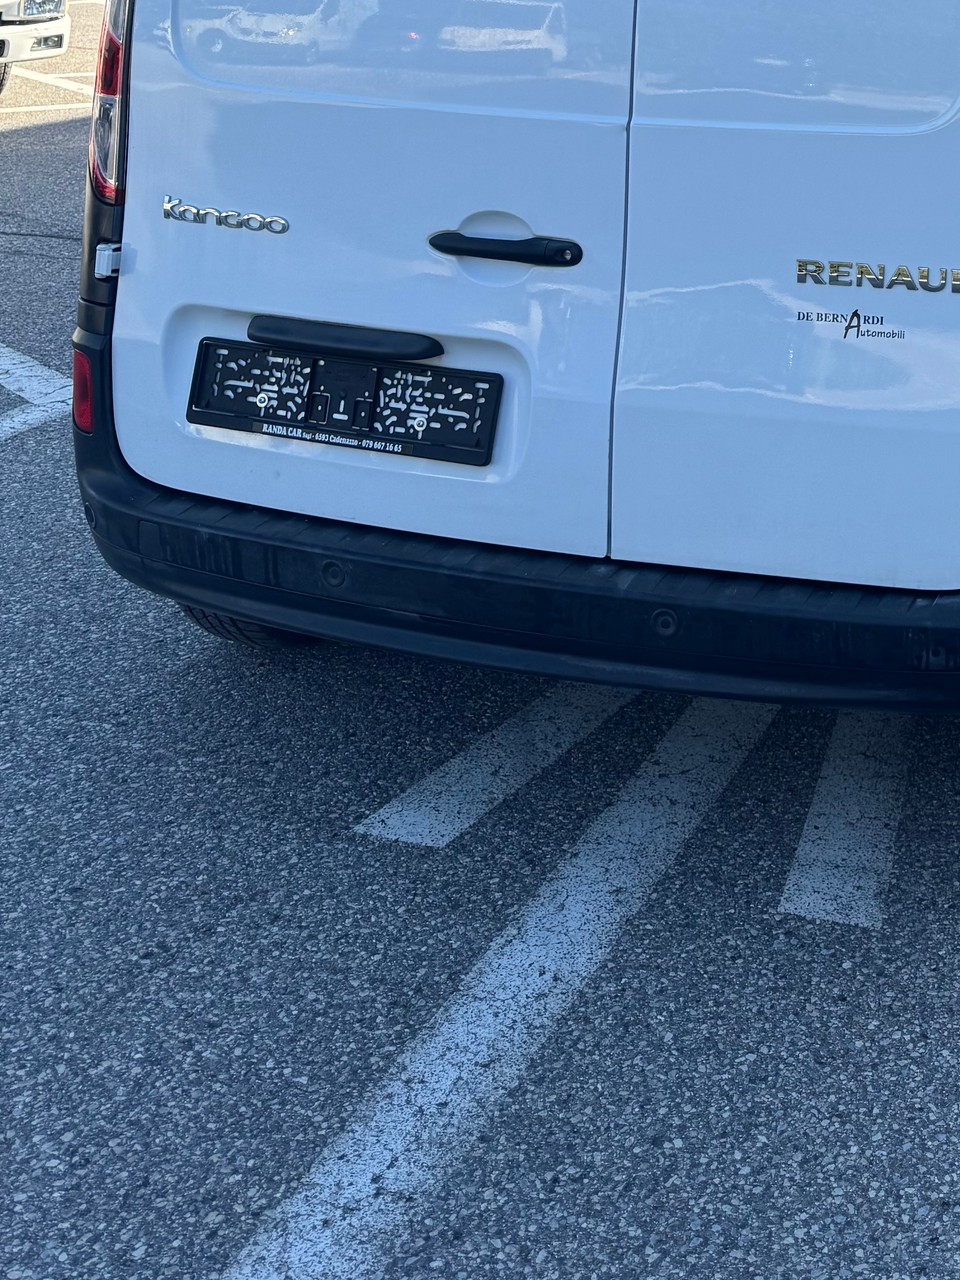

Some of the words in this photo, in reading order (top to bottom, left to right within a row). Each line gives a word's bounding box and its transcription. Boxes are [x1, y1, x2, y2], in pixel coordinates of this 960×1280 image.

[797, 311, 814, 322] DE
[816, 309, 884, 339] BERNARDI
[262, 423, 287, 436] RANDA
[287, 427, 302, 438] CAR
[315, 432, 329, 442] 6593
[361, 439, 374, 449] 079
[373, 441, 386, 451] 667
[385, 442, 394, 452] 16
[393, 444, 403, 453] 65
